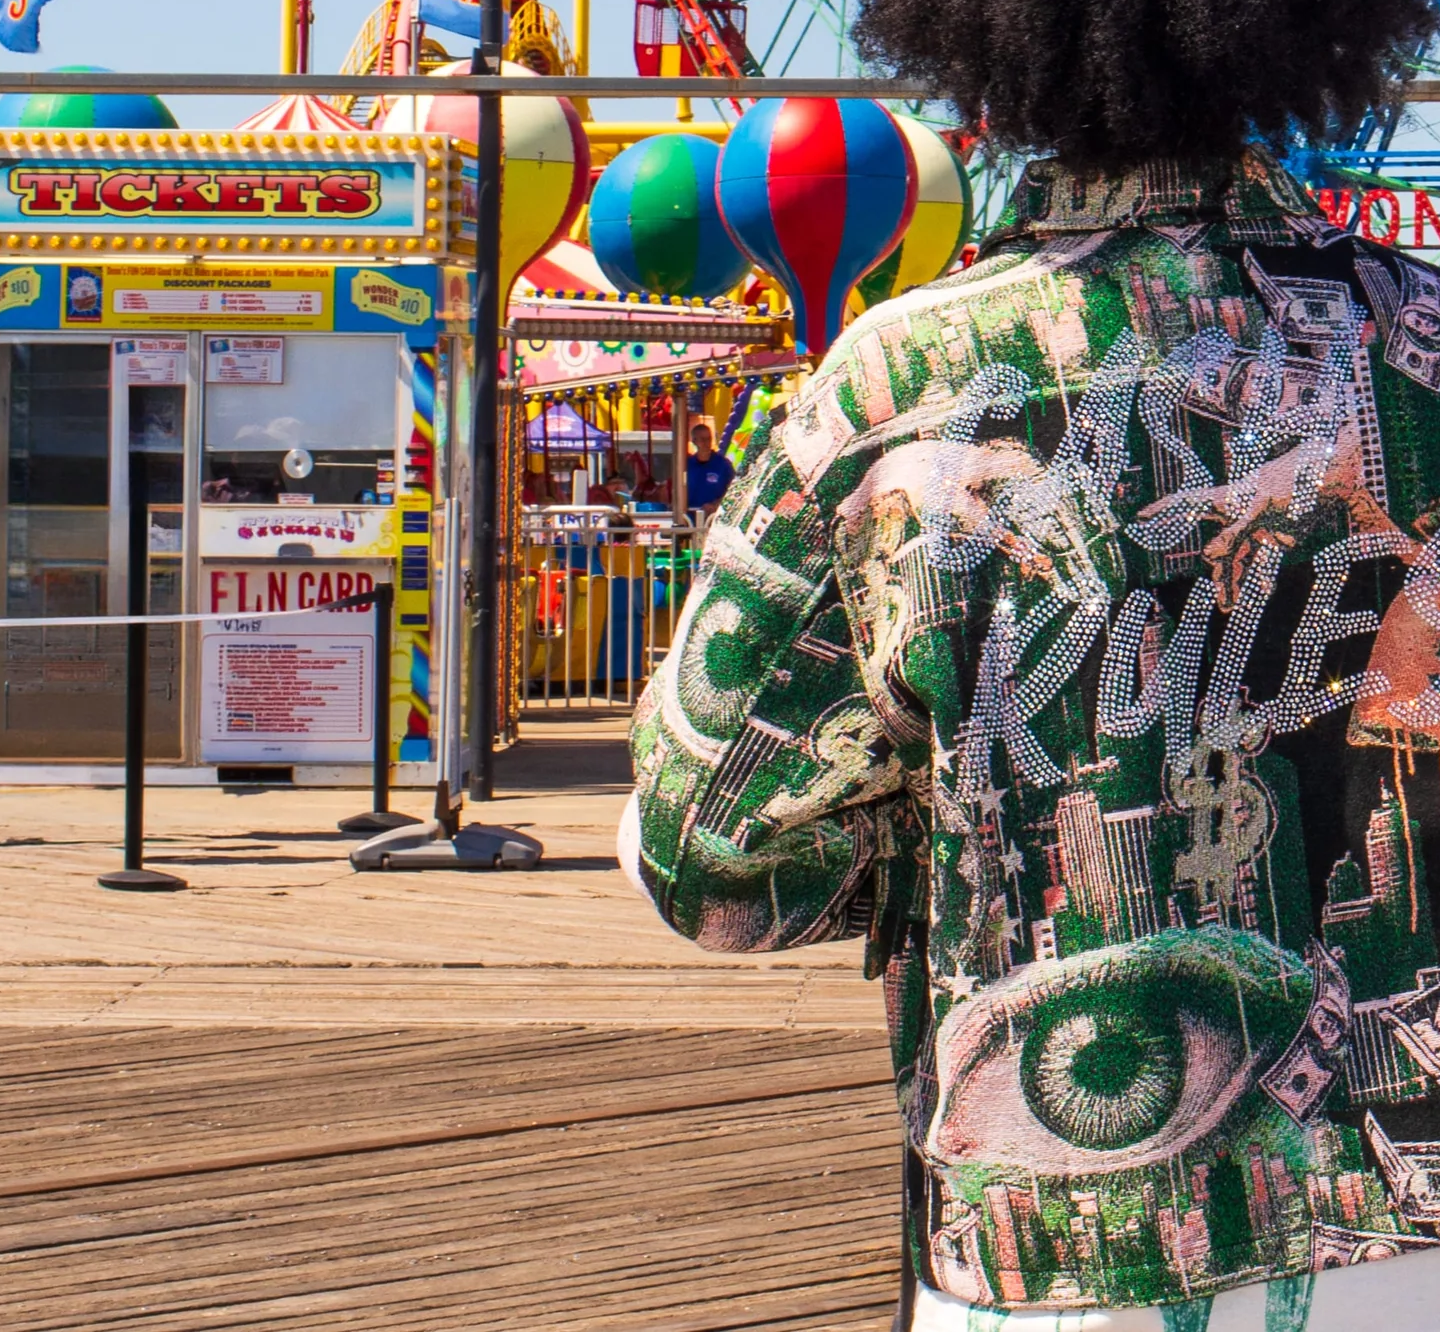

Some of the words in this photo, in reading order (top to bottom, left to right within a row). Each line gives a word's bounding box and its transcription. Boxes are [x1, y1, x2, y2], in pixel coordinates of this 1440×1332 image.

[17, 171, 373, 215] TICKETS
[11, 279, 29, 294] $10
[163, 279, 215, 288] DISCOUNT
[218, 279, 271, 288] PACKAGES
[363, 284, 399, 298] WONDER
[400, 298, 419, 314] $10
[298, 571, 374, 613] CARD
